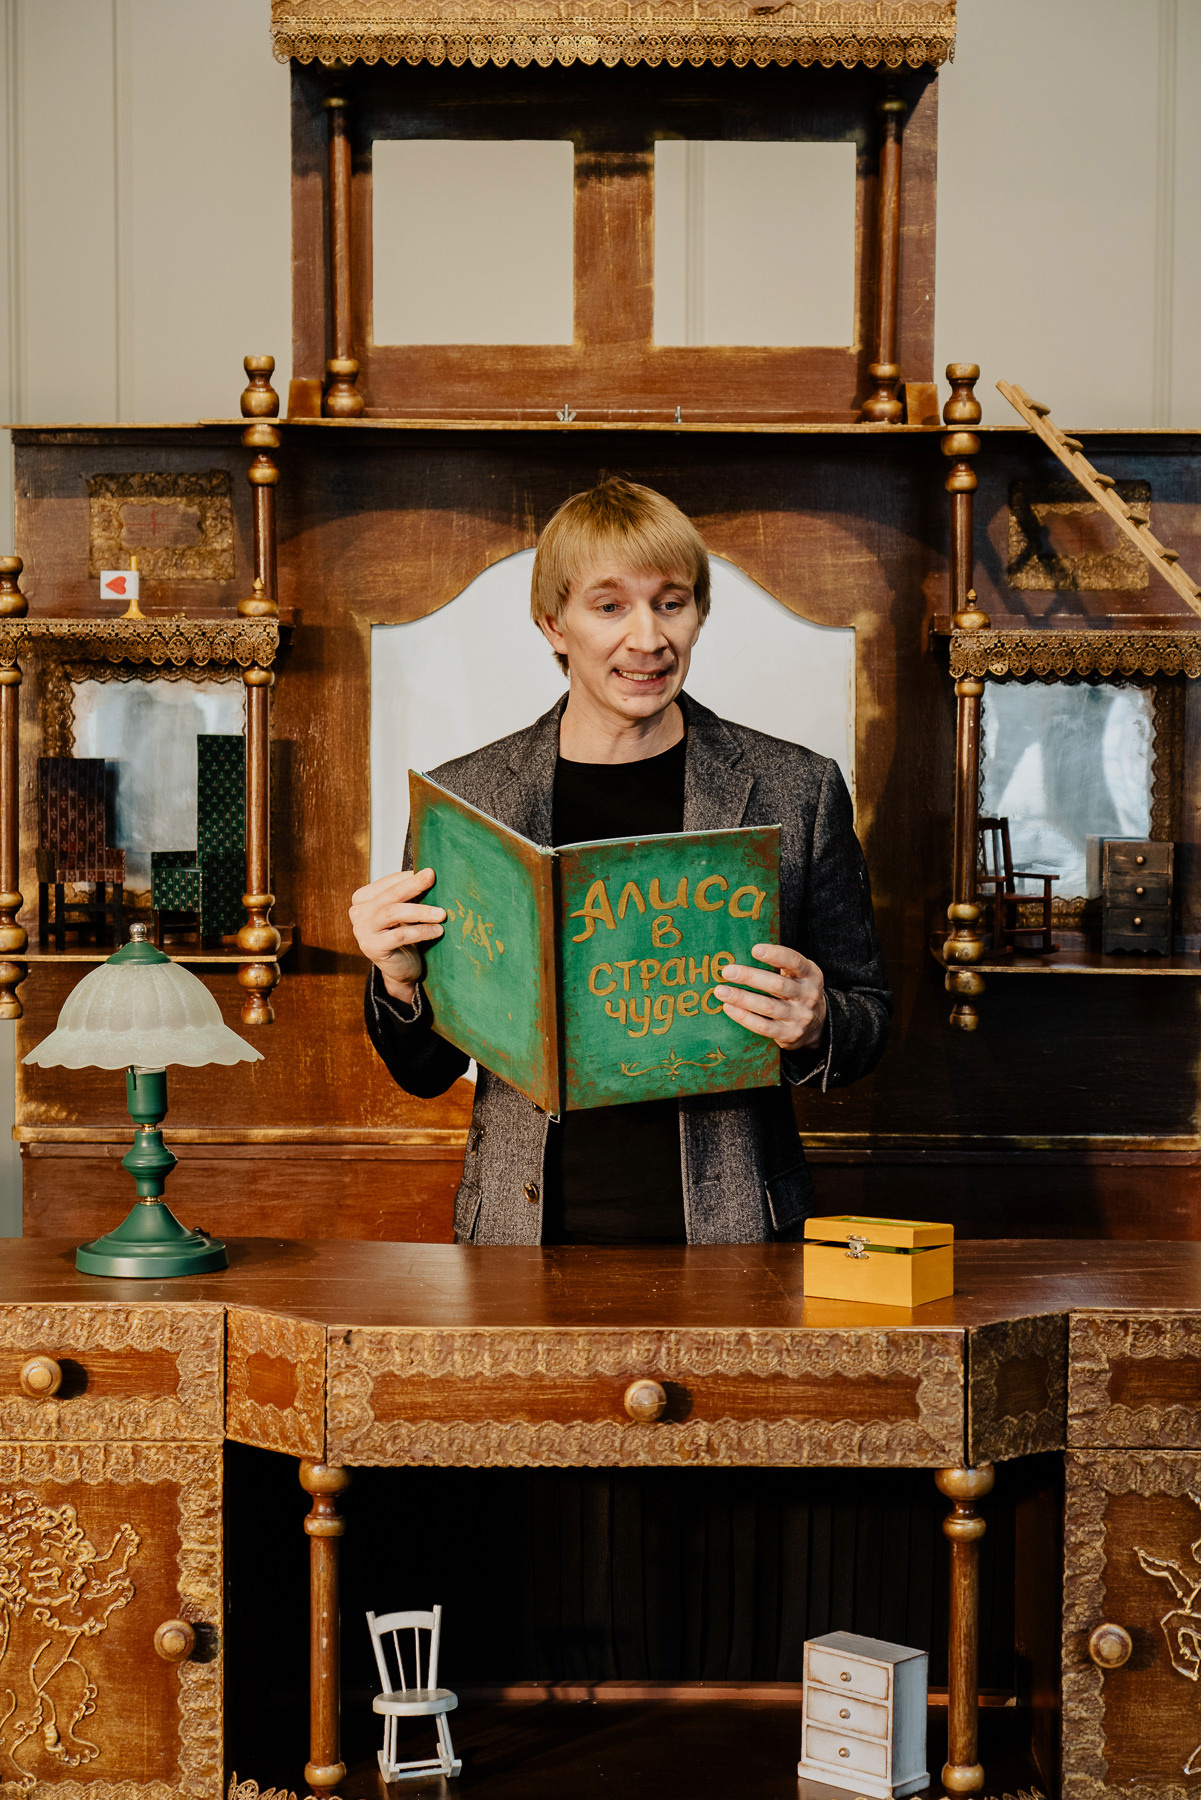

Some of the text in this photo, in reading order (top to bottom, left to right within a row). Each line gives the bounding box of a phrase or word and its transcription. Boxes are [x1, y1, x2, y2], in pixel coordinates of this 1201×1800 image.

[570, 874, 767, 943] Алиса
[588, 951, 736, 996] стране
[605, 987, 725, 1038] чудес
